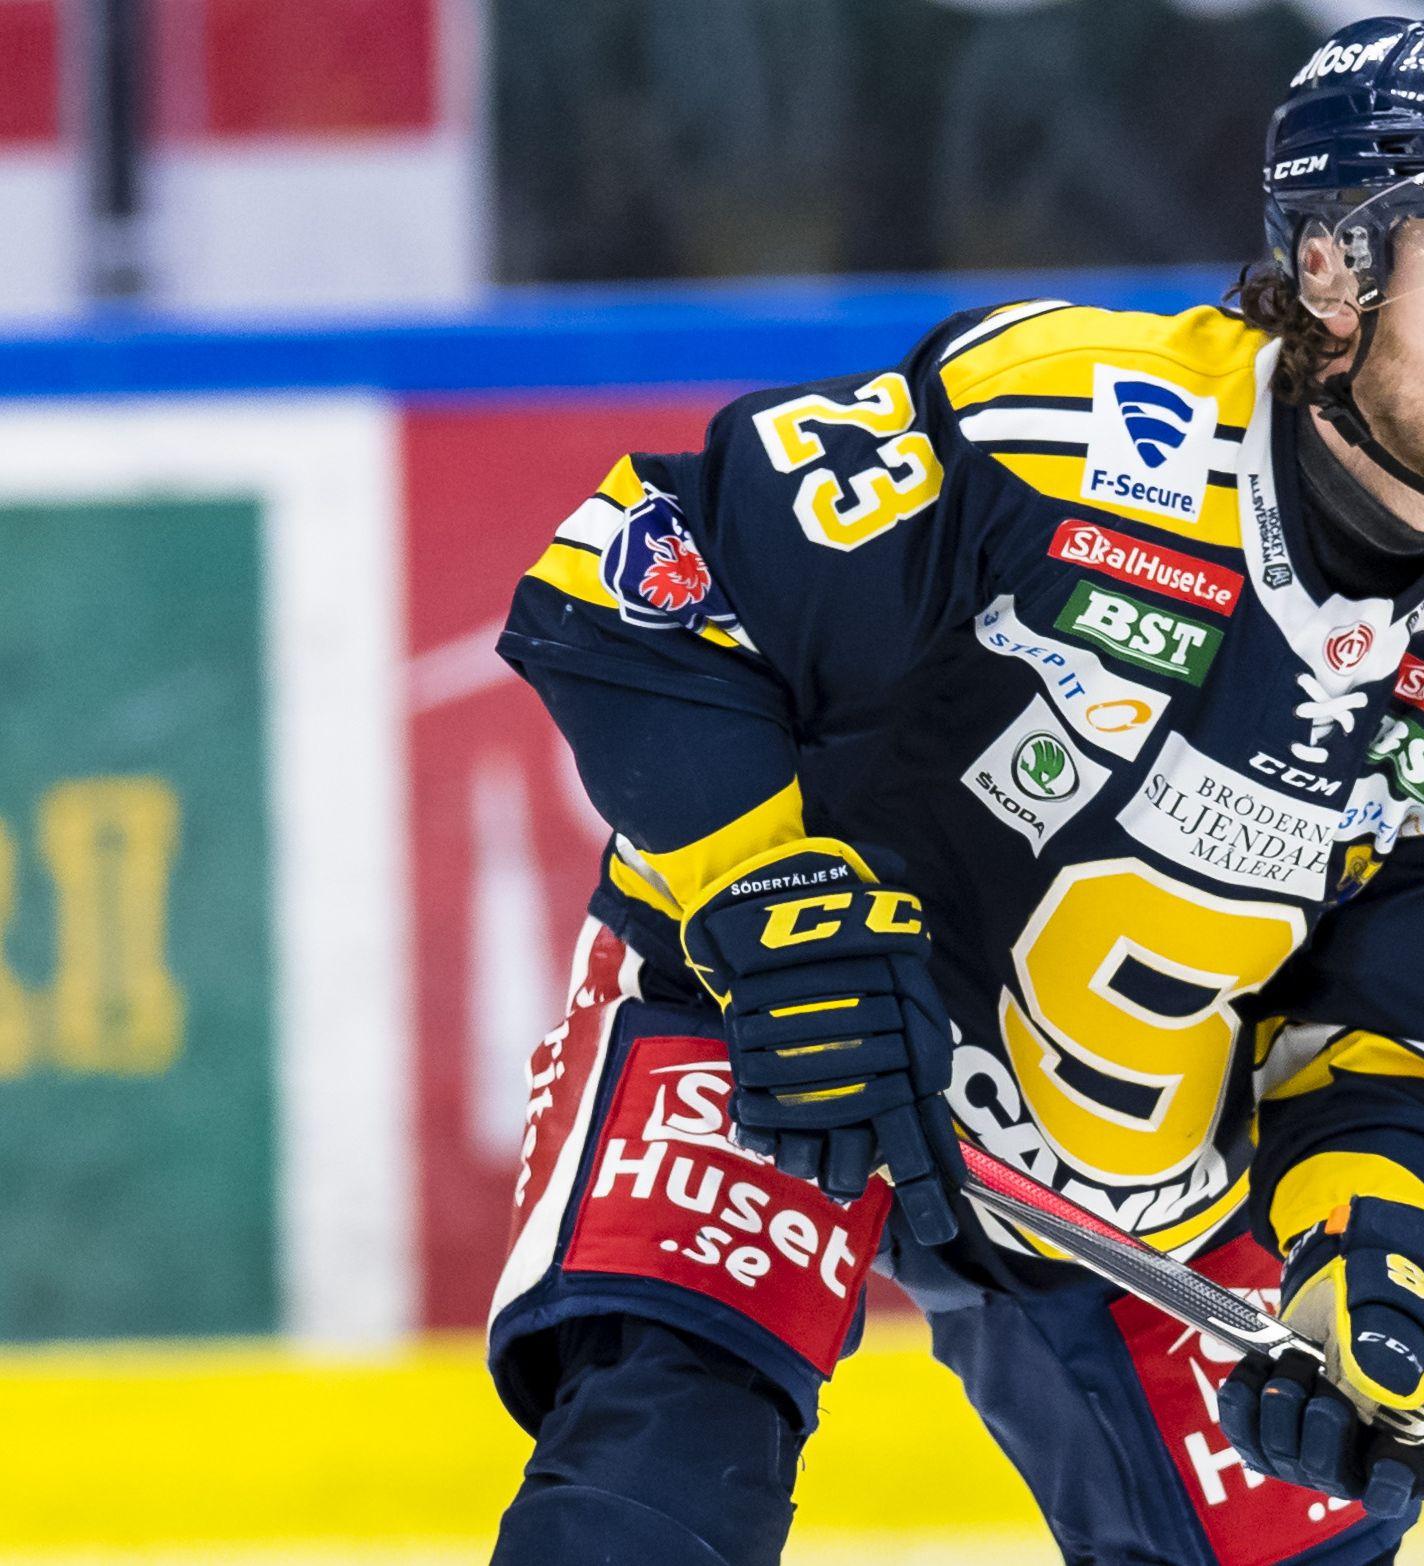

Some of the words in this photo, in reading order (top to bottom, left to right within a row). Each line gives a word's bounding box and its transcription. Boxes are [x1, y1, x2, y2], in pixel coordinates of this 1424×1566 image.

[1274, 153, 1329, 180] CCM
[752, 372, 944, 552] 23
[1090, 468, 1195, 513] F-Secure
[1075, 590, 1207, 665] BST
[988, 632, 1065, 668] STEP
[1057, 672, 1088, 701] IT
[974, 771, 1047, 839] ŠKODA
[1249, 751, 1342, 797] CCM
[730, 872, 828, 897] SÖDERTÄLJE
[829, 864, 849, 881] SK
[759, 889, 931, 950] CC
[591, 1137, 857, 1299] Huset
